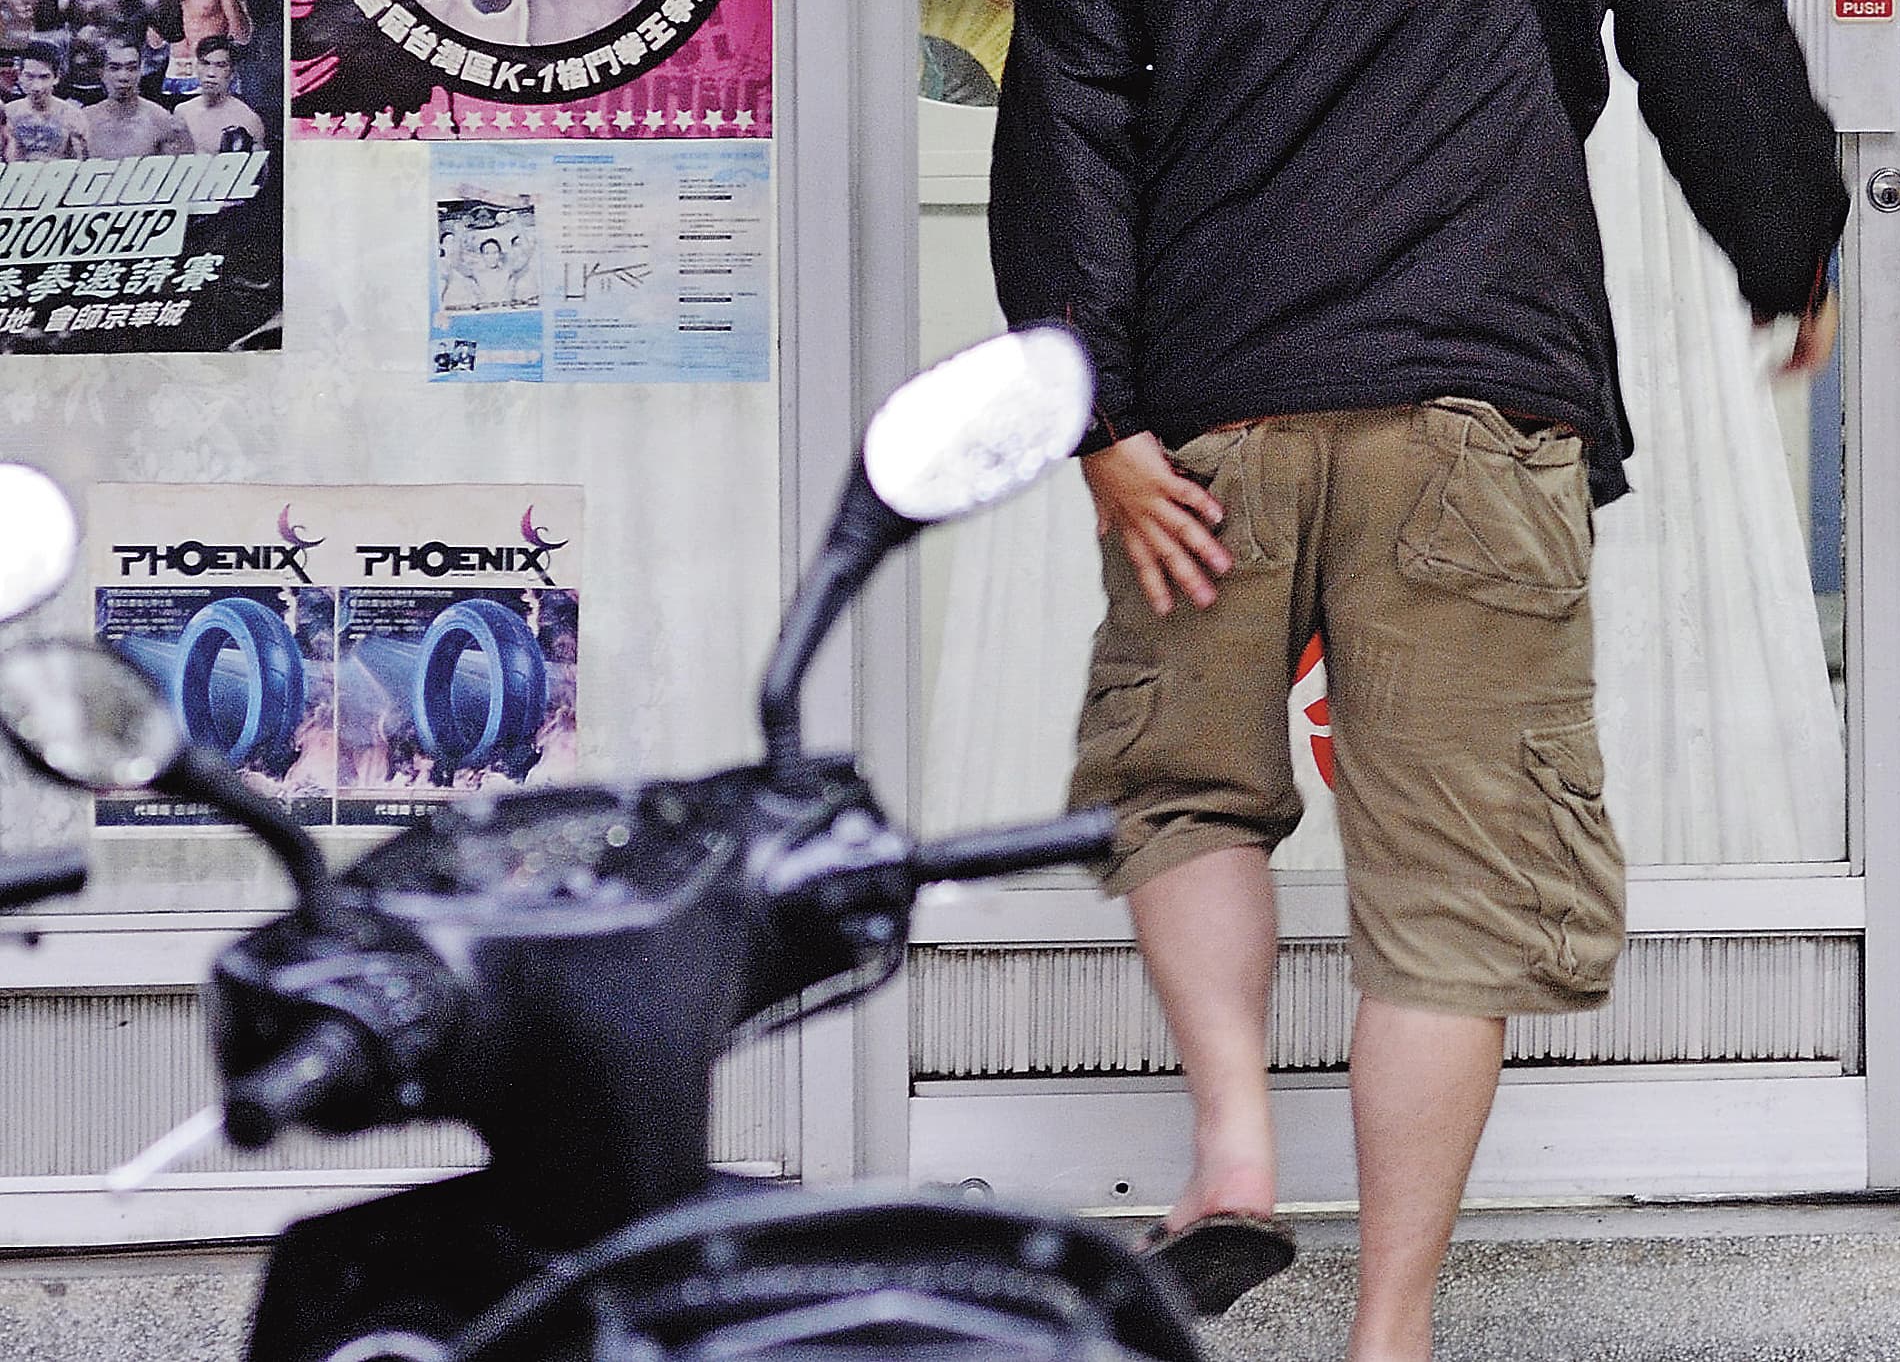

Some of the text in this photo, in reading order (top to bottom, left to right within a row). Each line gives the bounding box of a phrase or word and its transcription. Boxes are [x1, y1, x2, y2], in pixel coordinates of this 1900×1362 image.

[1842, 1, 1886, 15] PUSH
[112, 538, 556, 586] PHOENIX PHOENIX
